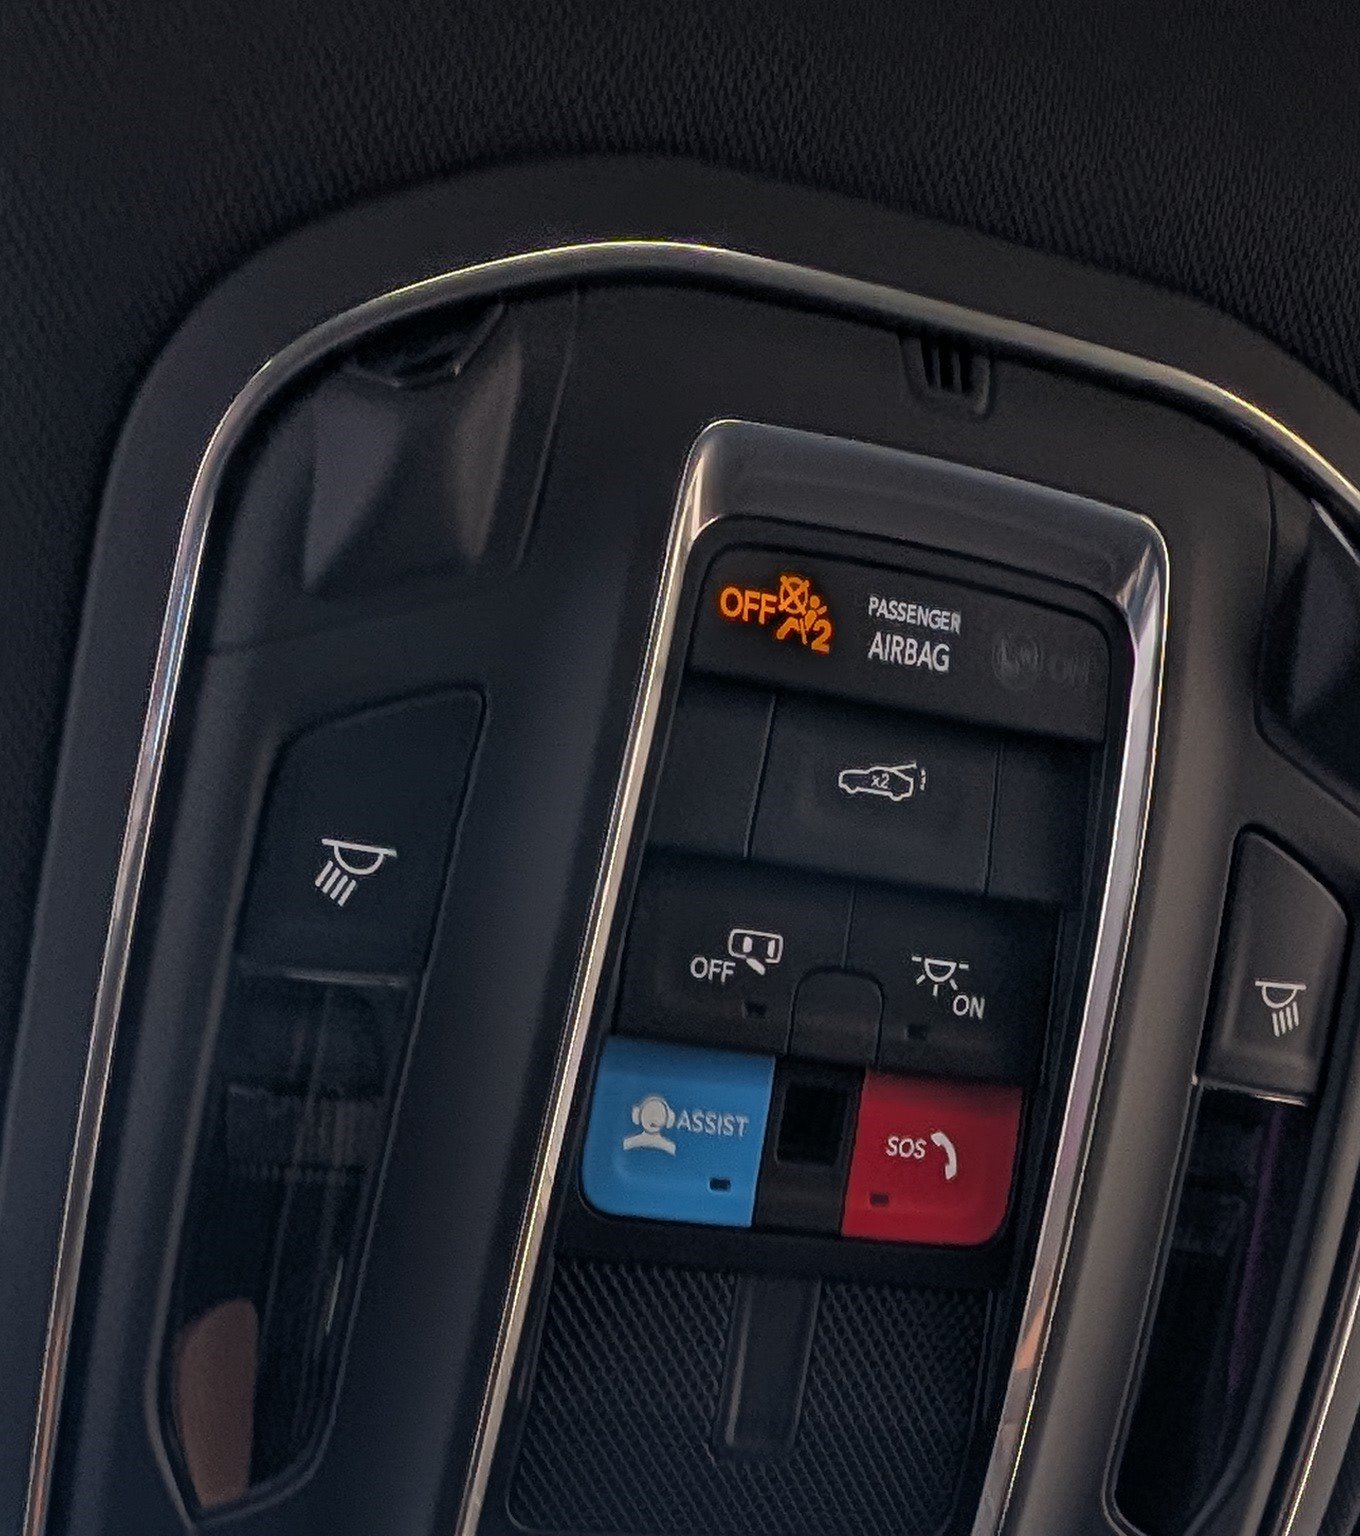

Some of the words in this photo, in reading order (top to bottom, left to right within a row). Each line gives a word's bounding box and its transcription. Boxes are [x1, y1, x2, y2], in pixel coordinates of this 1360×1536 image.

[720, 587, 776, 626] OFF
[868, 596, 962, 634] PASSENGER
[868, 632, 951, 673] AIRBAG
[690, 956, 736, 984] OFF
[953, 994, 986, 1020] ON
[677, 1112, 750, 1138] ASSIST
[886, 1135, 927, 1160] SOS
